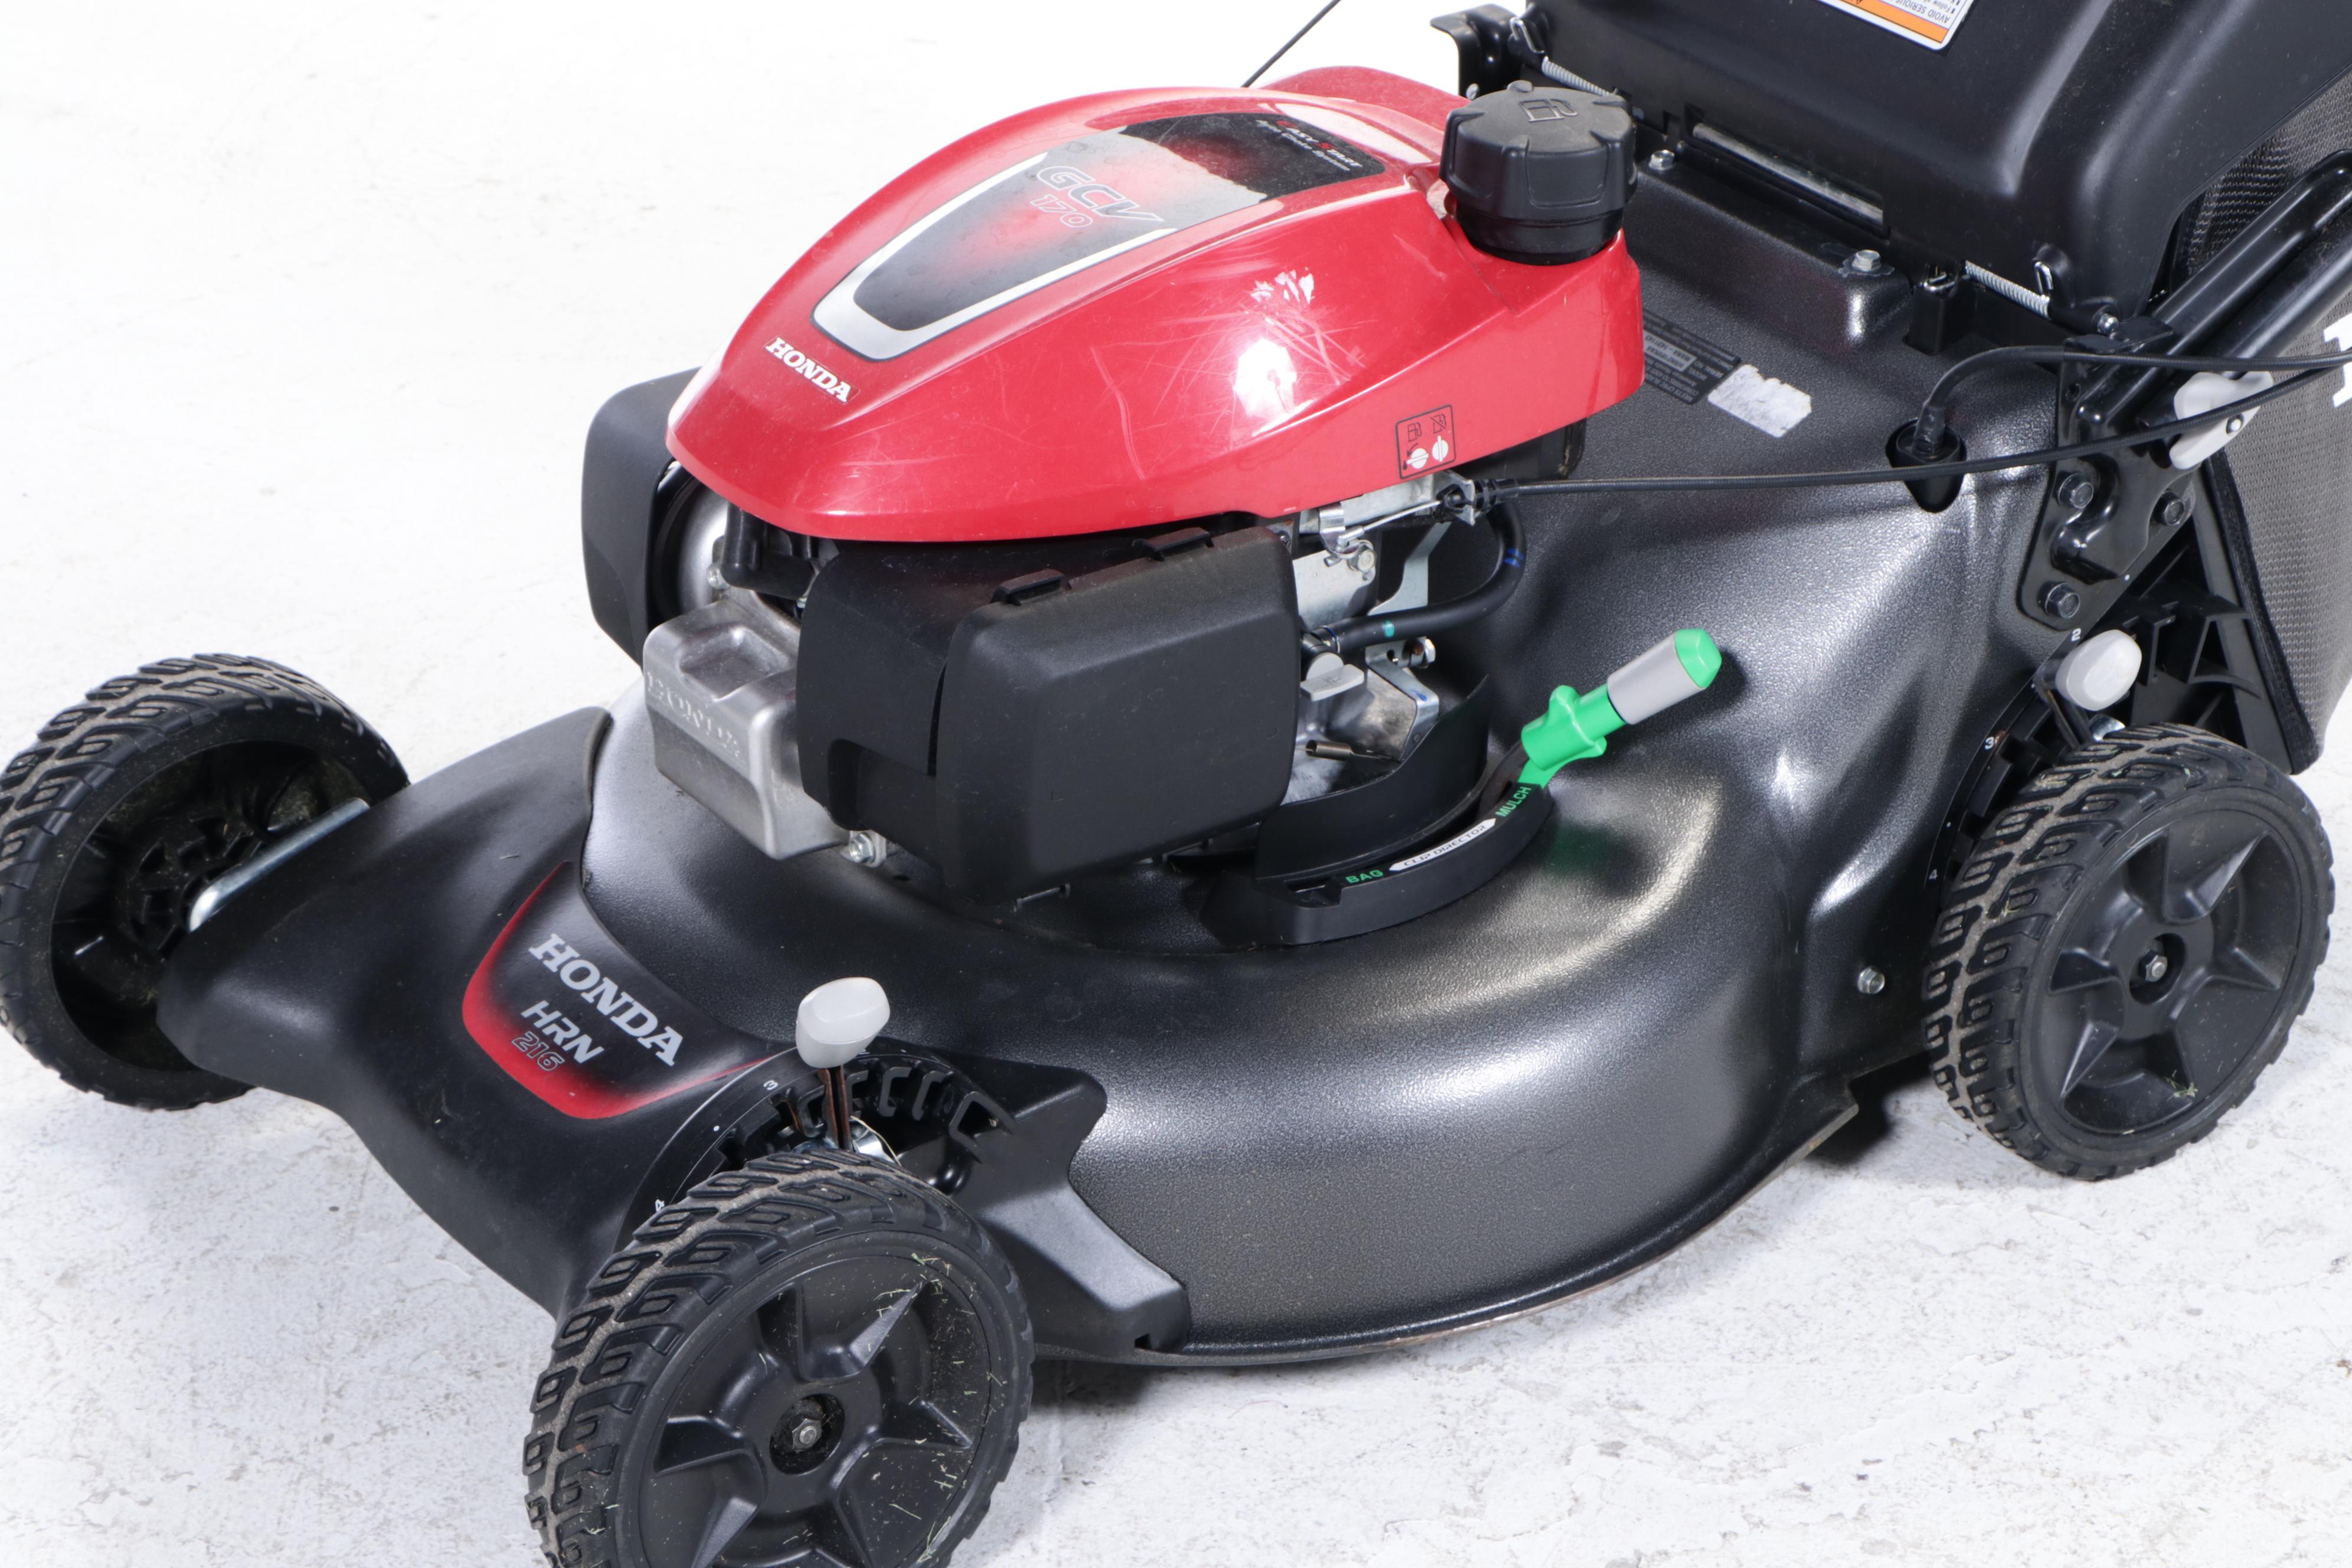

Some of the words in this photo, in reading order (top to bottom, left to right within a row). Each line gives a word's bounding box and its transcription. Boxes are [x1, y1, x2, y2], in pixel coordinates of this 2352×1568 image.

[1928, 9, 1950, 23] AVOID
[1037, 166, 1165, 221] GCV
[1030, 194, 1093, 227] 170
[765, 337, 851, 402] HONDA
[2072, 628, 2081, 642] 2
[1985, 737, 1994, 750] 3
[1495, 786, 1532, 817] MULCH
[1404, 853, 1430, 866] CLIP
[1433, 825, 1486, 855] DIRECTOR
[1345, 870, 1384, 884] BAG
[1929, 869, 1938, 880] 4
[528, 933, 683, 1067] HONDA
[521, 1000, 605, 1064] HRN
[511, 1031, 565, 1071] 216
[763, 1080, 778, 1090] 3
